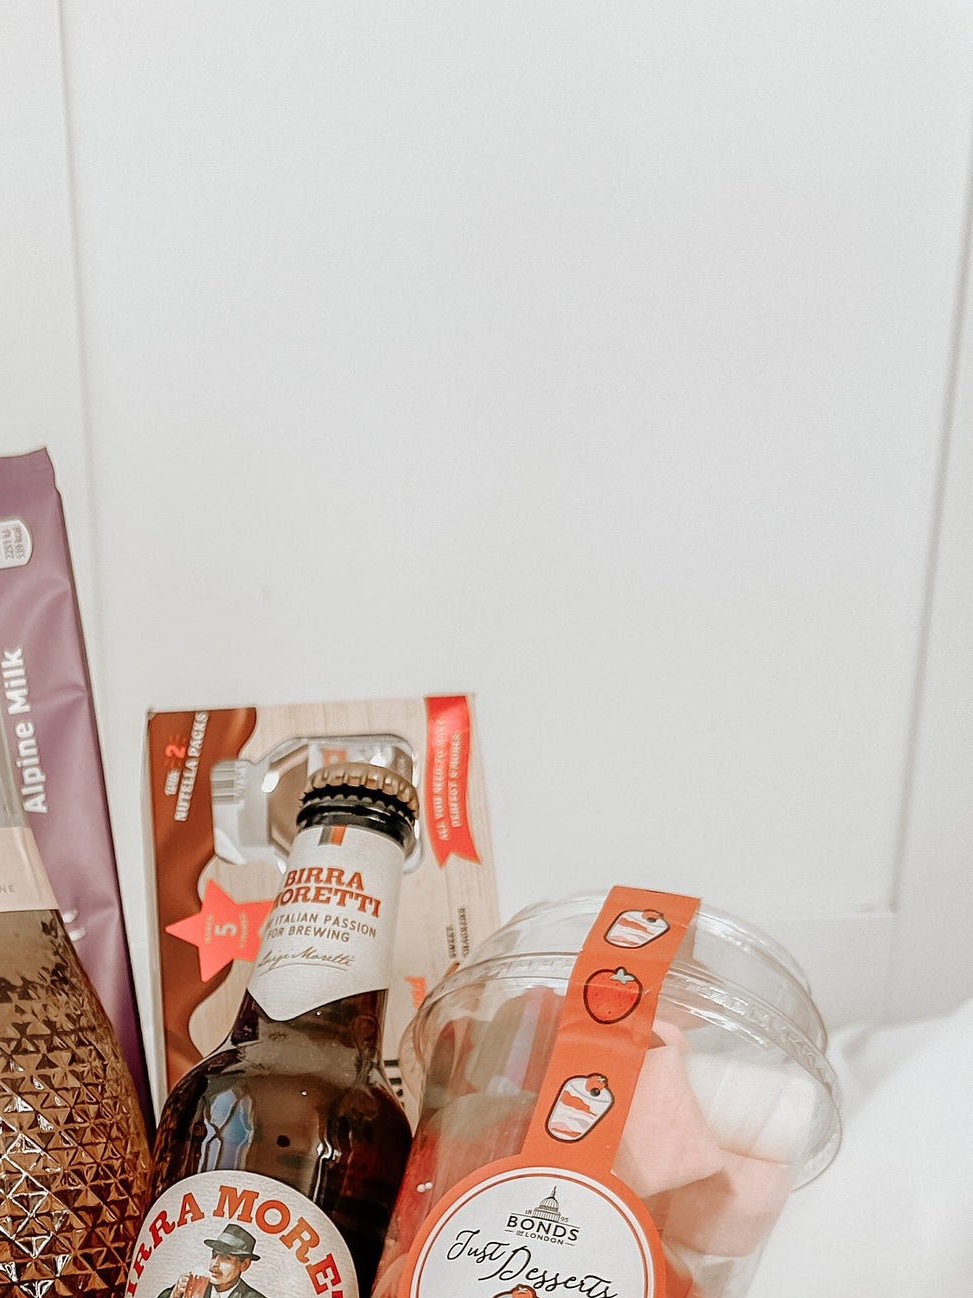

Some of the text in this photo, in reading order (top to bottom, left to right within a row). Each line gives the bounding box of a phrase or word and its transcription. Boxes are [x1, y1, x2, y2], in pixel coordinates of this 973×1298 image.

[0, 646, 48, 815] Alpine Milk
[165, 744, 186, 759] 2
[174, 711, 209, 821] NUTELLA PACKS
[284, 867, 364, 891] BIRRA
[215, 923, 237, 937] 5
[267, 925, 350, 943] FOR BREWING
[275, 912, 318, 926] ITALIAN
[324, 915, 376, 939] PASSION
[506, 1215, 580, 1242] BONDS
[524, 1231, 565, 1246] LONDON
[447, 1229, 510, 1263] Just
